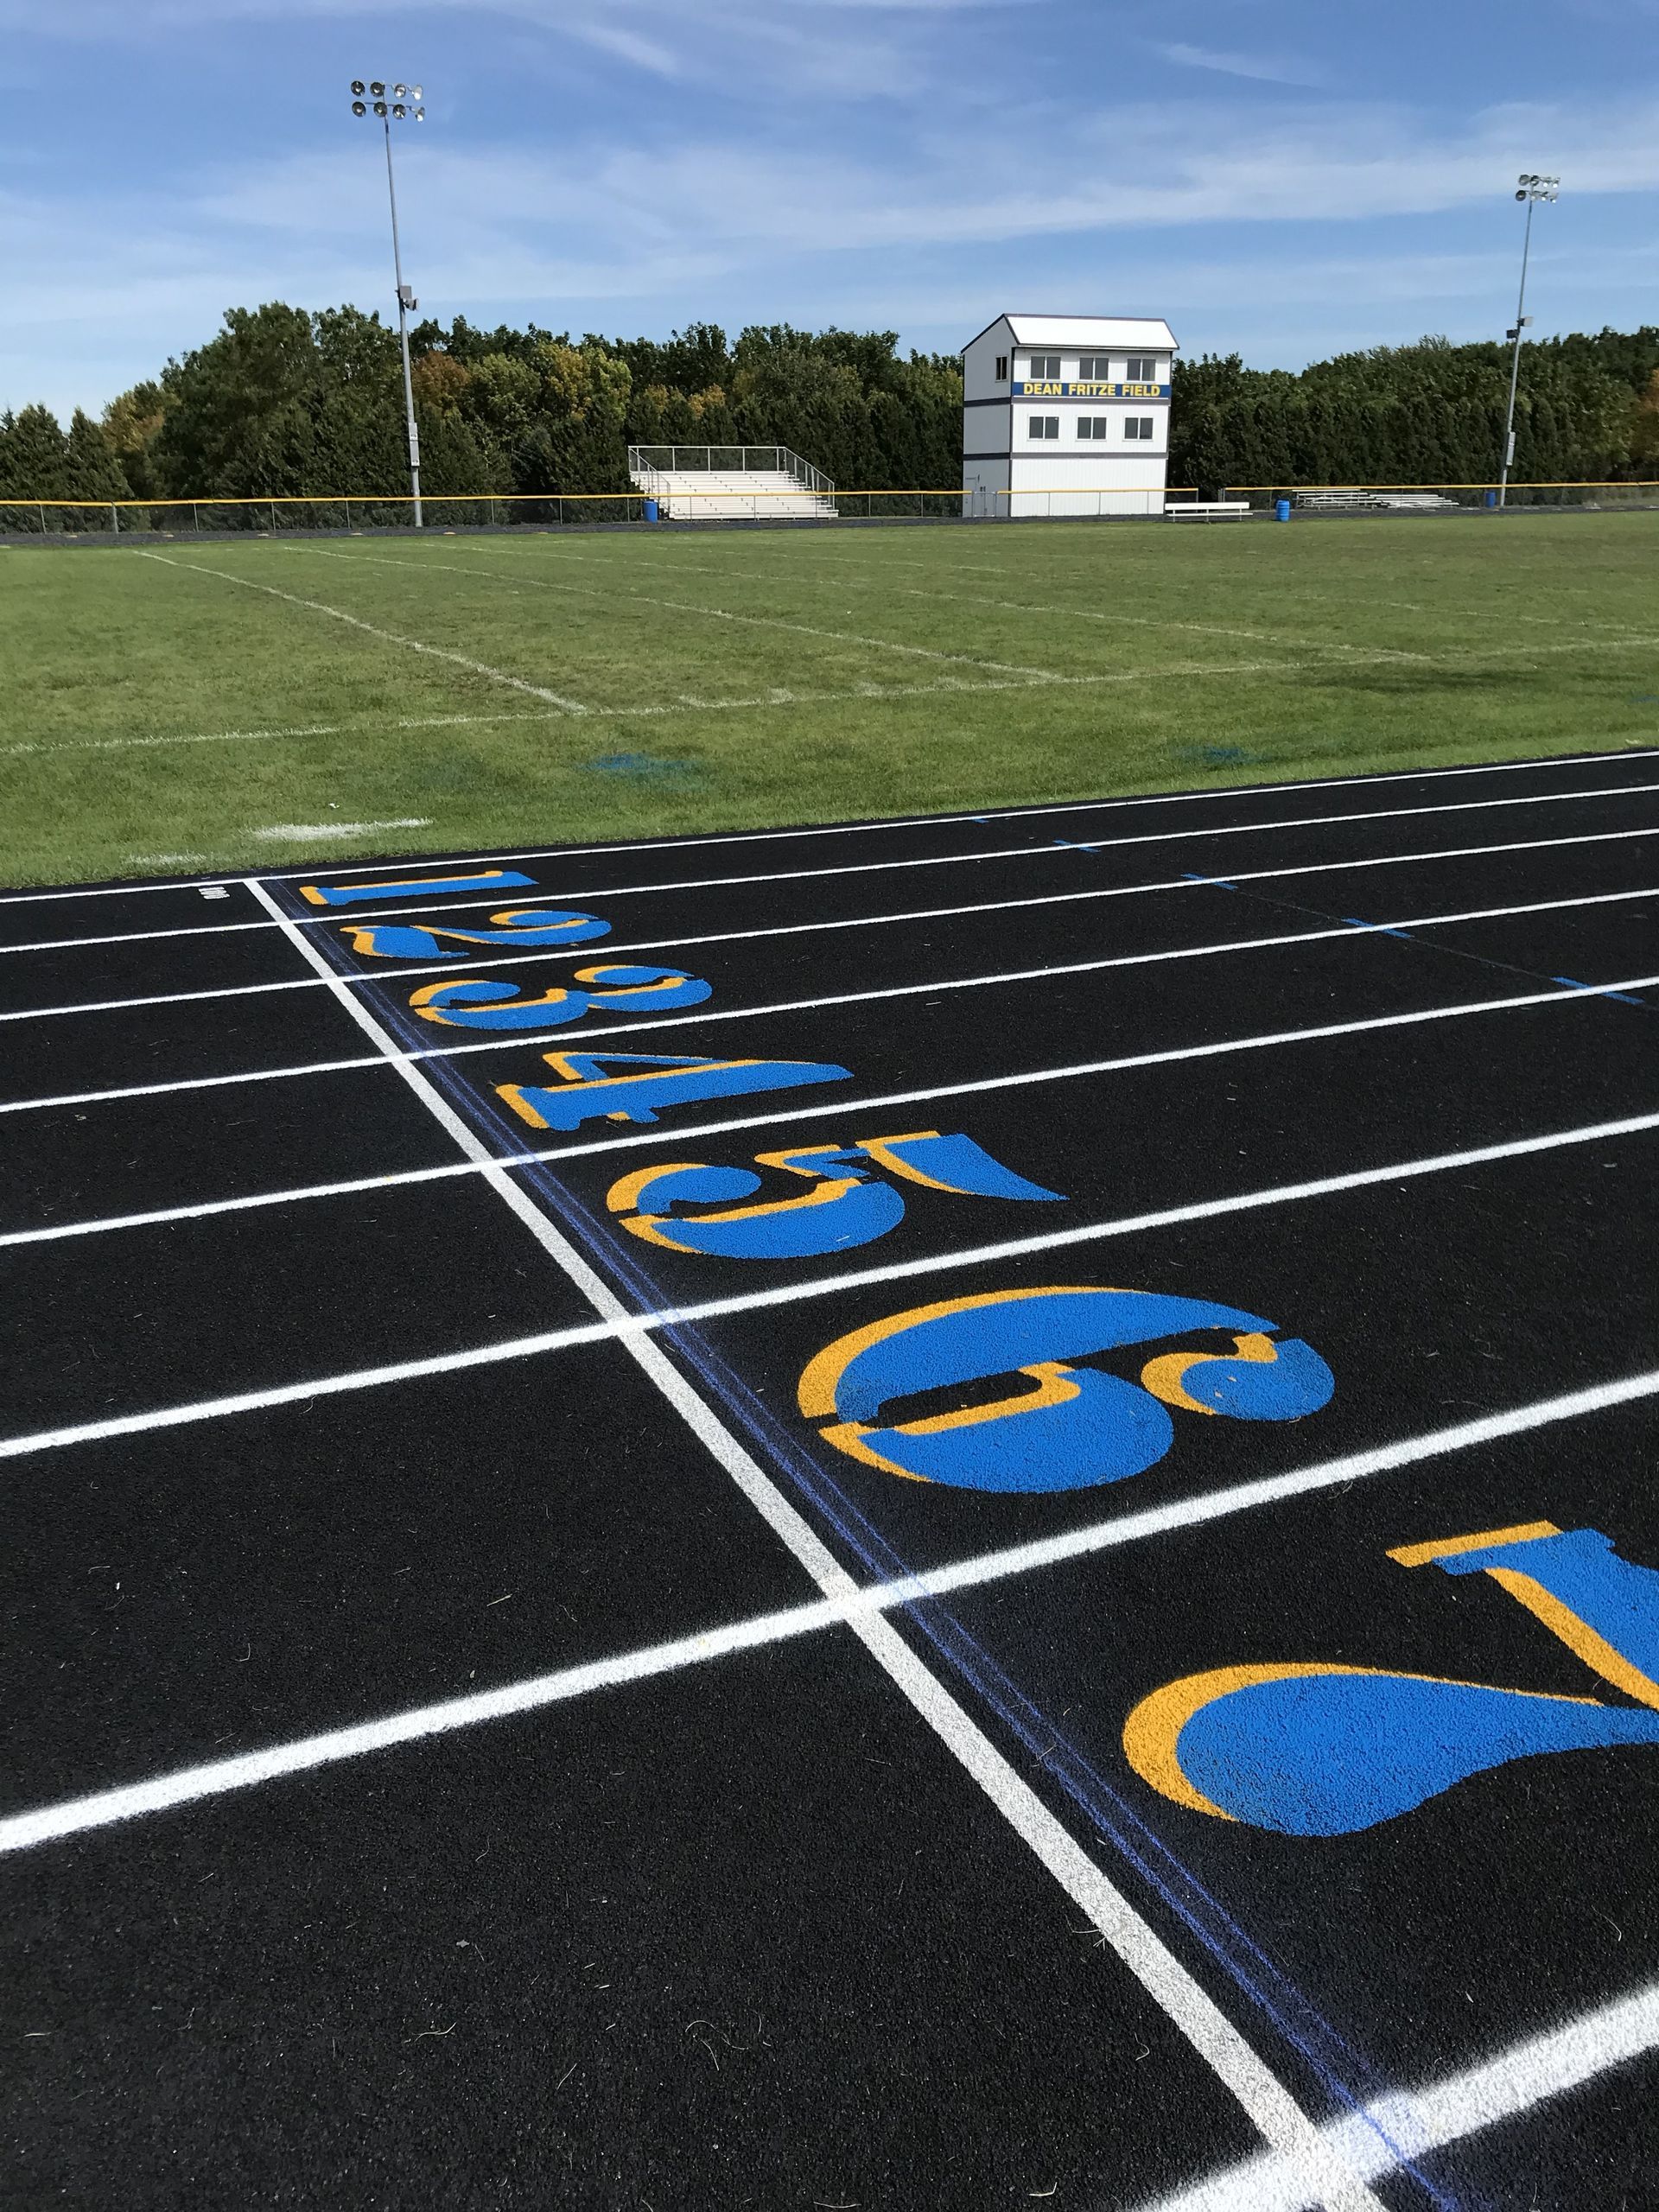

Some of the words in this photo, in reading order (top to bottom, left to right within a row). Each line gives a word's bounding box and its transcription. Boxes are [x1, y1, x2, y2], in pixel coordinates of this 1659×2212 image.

[1023, 383, 1063, 396] DEAN
[1068, 384, 1116, 397] FRITZE
[1122, 385, 1161, 397] FIELD
[300, 871, 539, 906] 1
[340, 910, 613, 960] 2
[410, 965, 714, 1031] 3
[495, 1052, 855, 1132] 4
[607, 1131, 1069, 1260] 5
[797, 1286, 1336, 1494] 6
